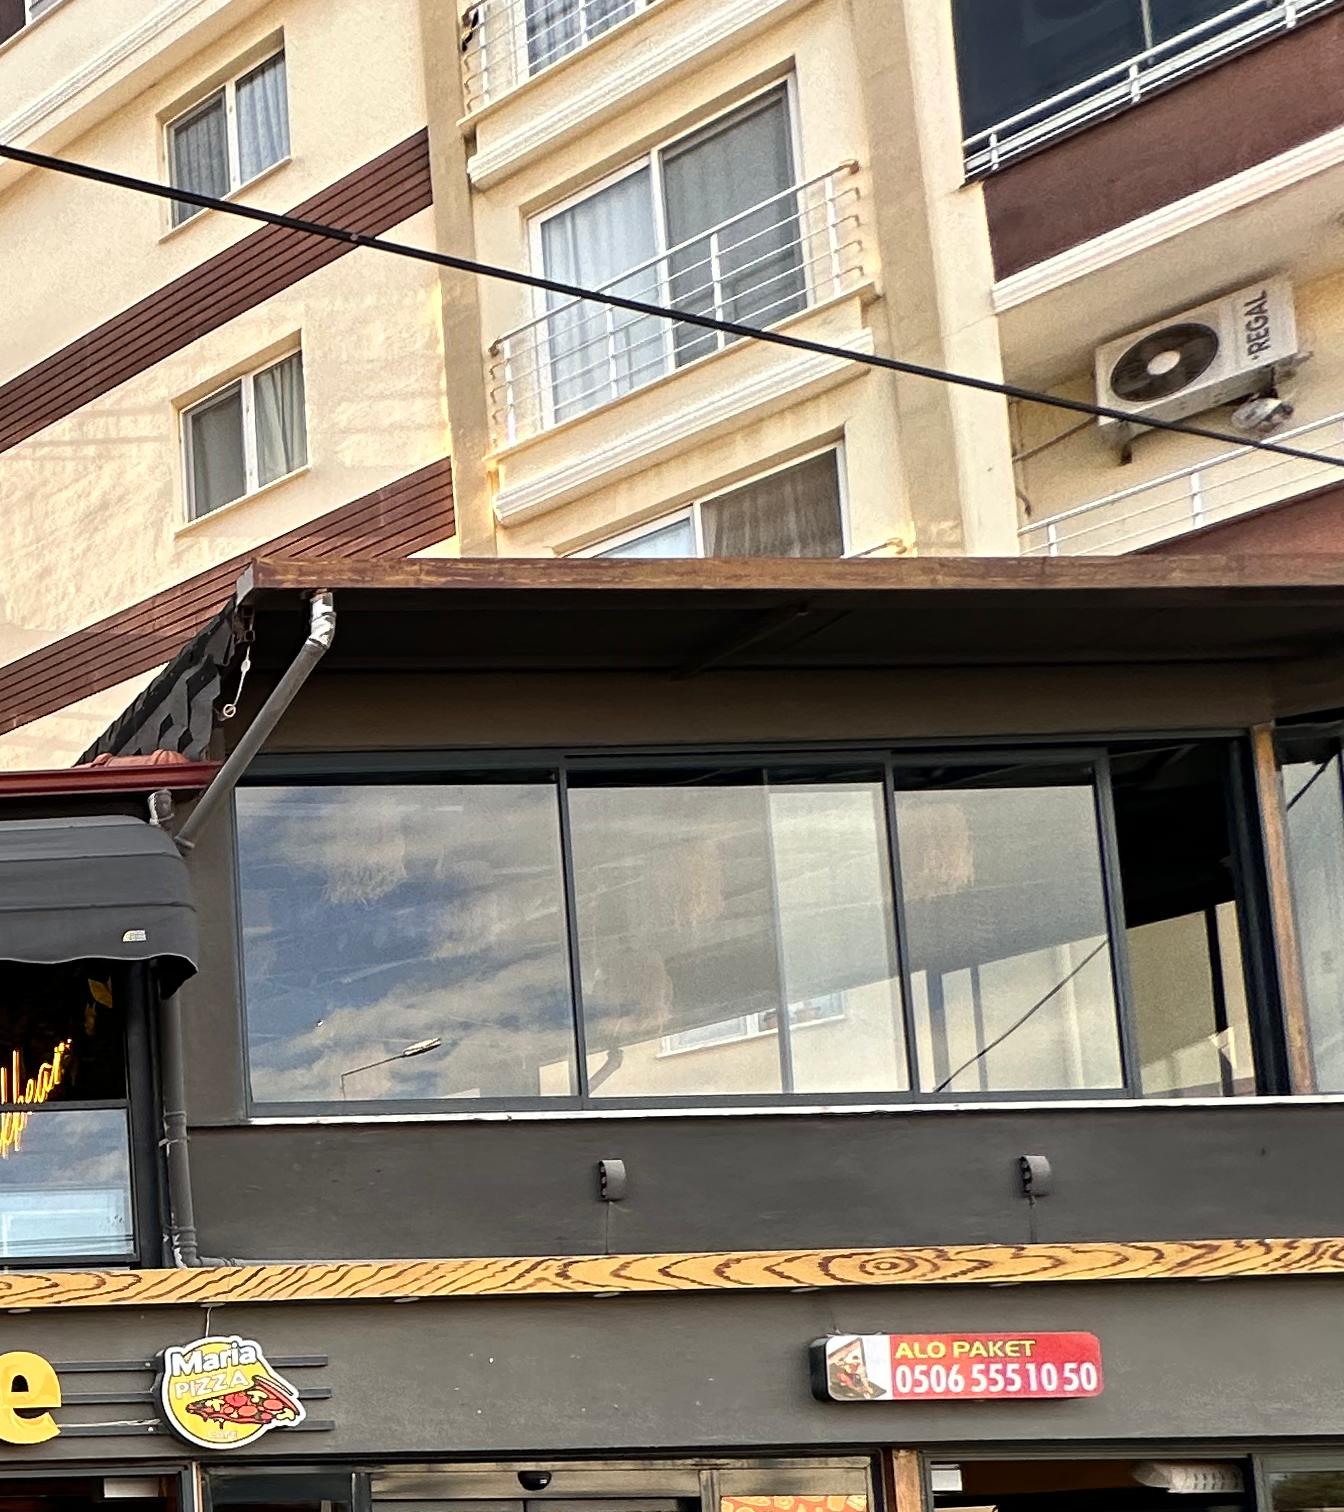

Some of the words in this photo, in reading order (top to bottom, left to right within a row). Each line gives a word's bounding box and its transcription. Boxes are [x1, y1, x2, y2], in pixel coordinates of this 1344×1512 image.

[1243, 290, 1271, 356] REGAL
[171, 1340, 258, 1377] Maria
[895, 1341, 946, 1359] ALO
[952, 1340, 1035, 1357] PAKET
[174, 1369, 250, 1400] PIZZA
[895, 1363, 965, 1393] 0506
[1063, 1361, 1097, 1391] 50
